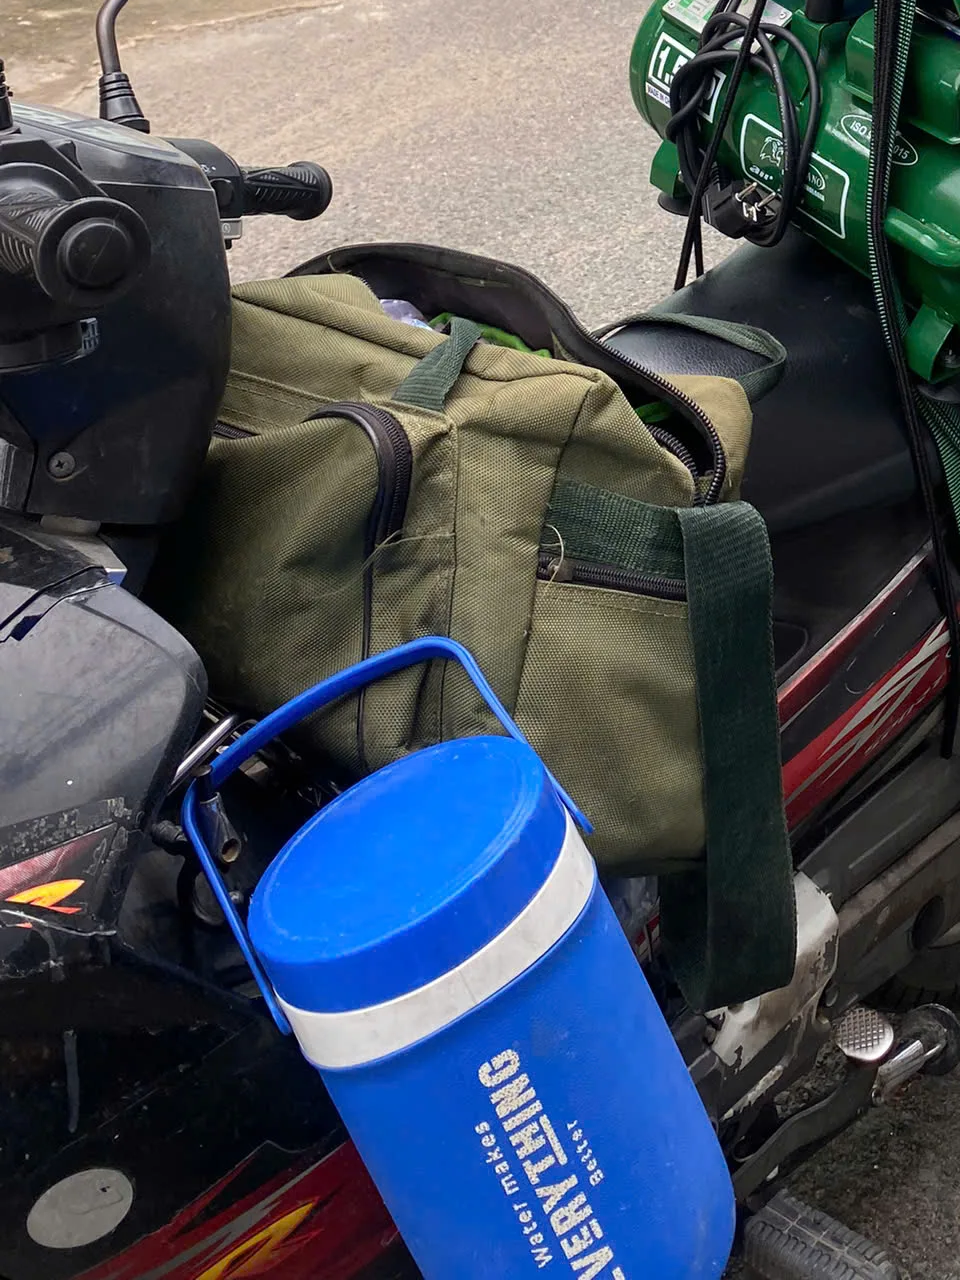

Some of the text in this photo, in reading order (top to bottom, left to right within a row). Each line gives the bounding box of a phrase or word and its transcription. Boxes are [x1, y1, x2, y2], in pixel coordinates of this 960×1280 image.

[850, 120, 868, 136] ISO
[474, 1121, 553, 1269] Water makes
[477, 1048, 626, 1280] VERYTHING
[566, 1119, 605, 1187] Better
